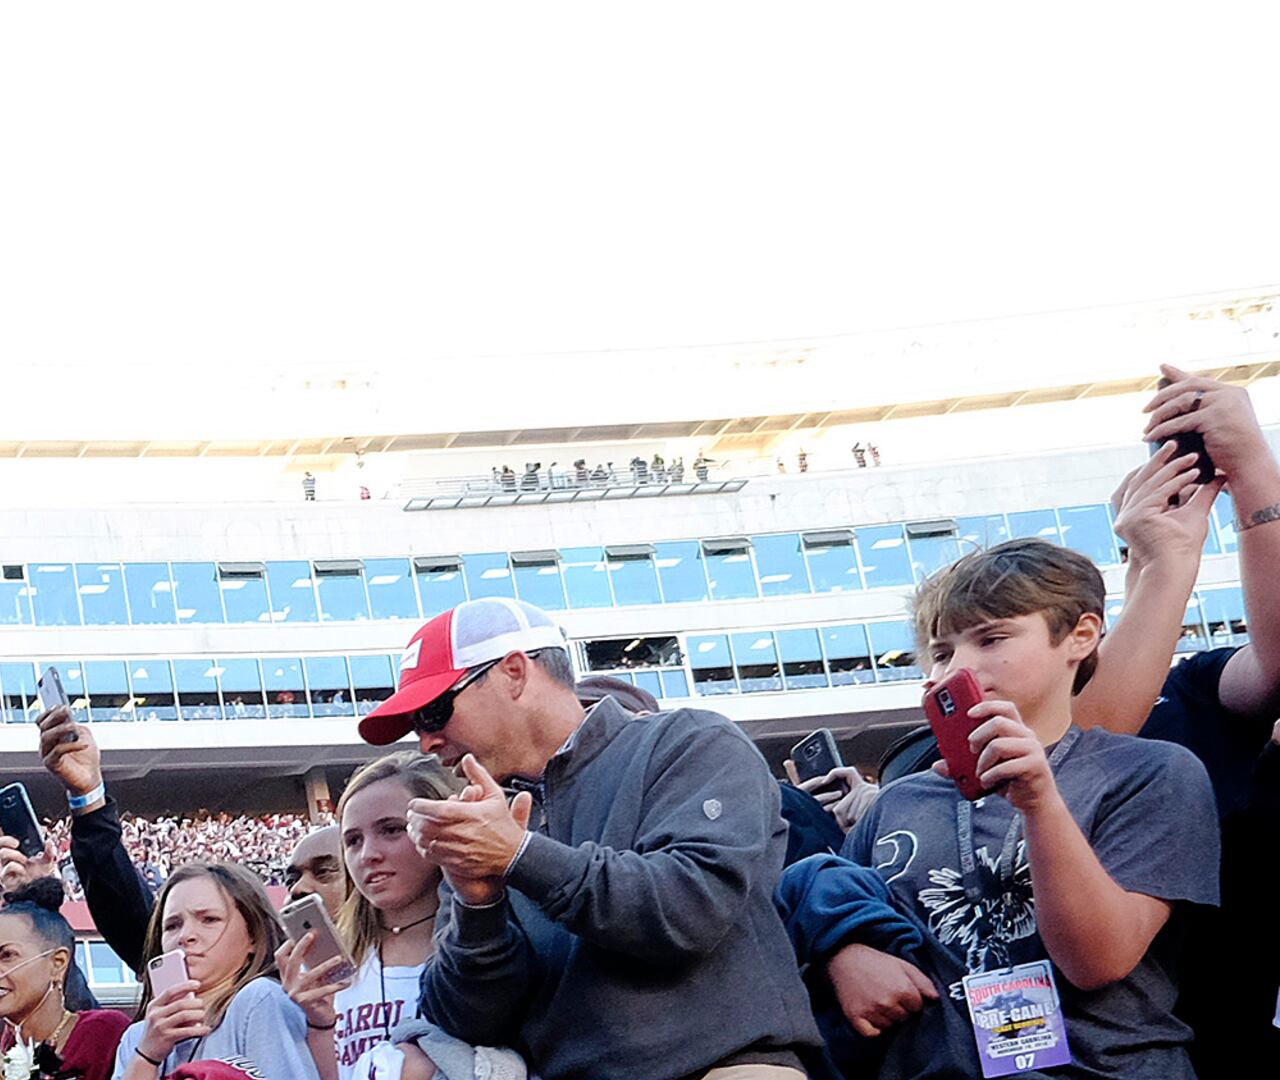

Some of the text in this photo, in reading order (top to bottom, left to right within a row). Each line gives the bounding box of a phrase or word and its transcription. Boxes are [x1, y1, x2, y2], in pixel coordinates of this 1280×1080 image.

[969, 974, 1054, 1007] SOUTH CAROLINA
[1014, 1053, 1035, 1070] 07
